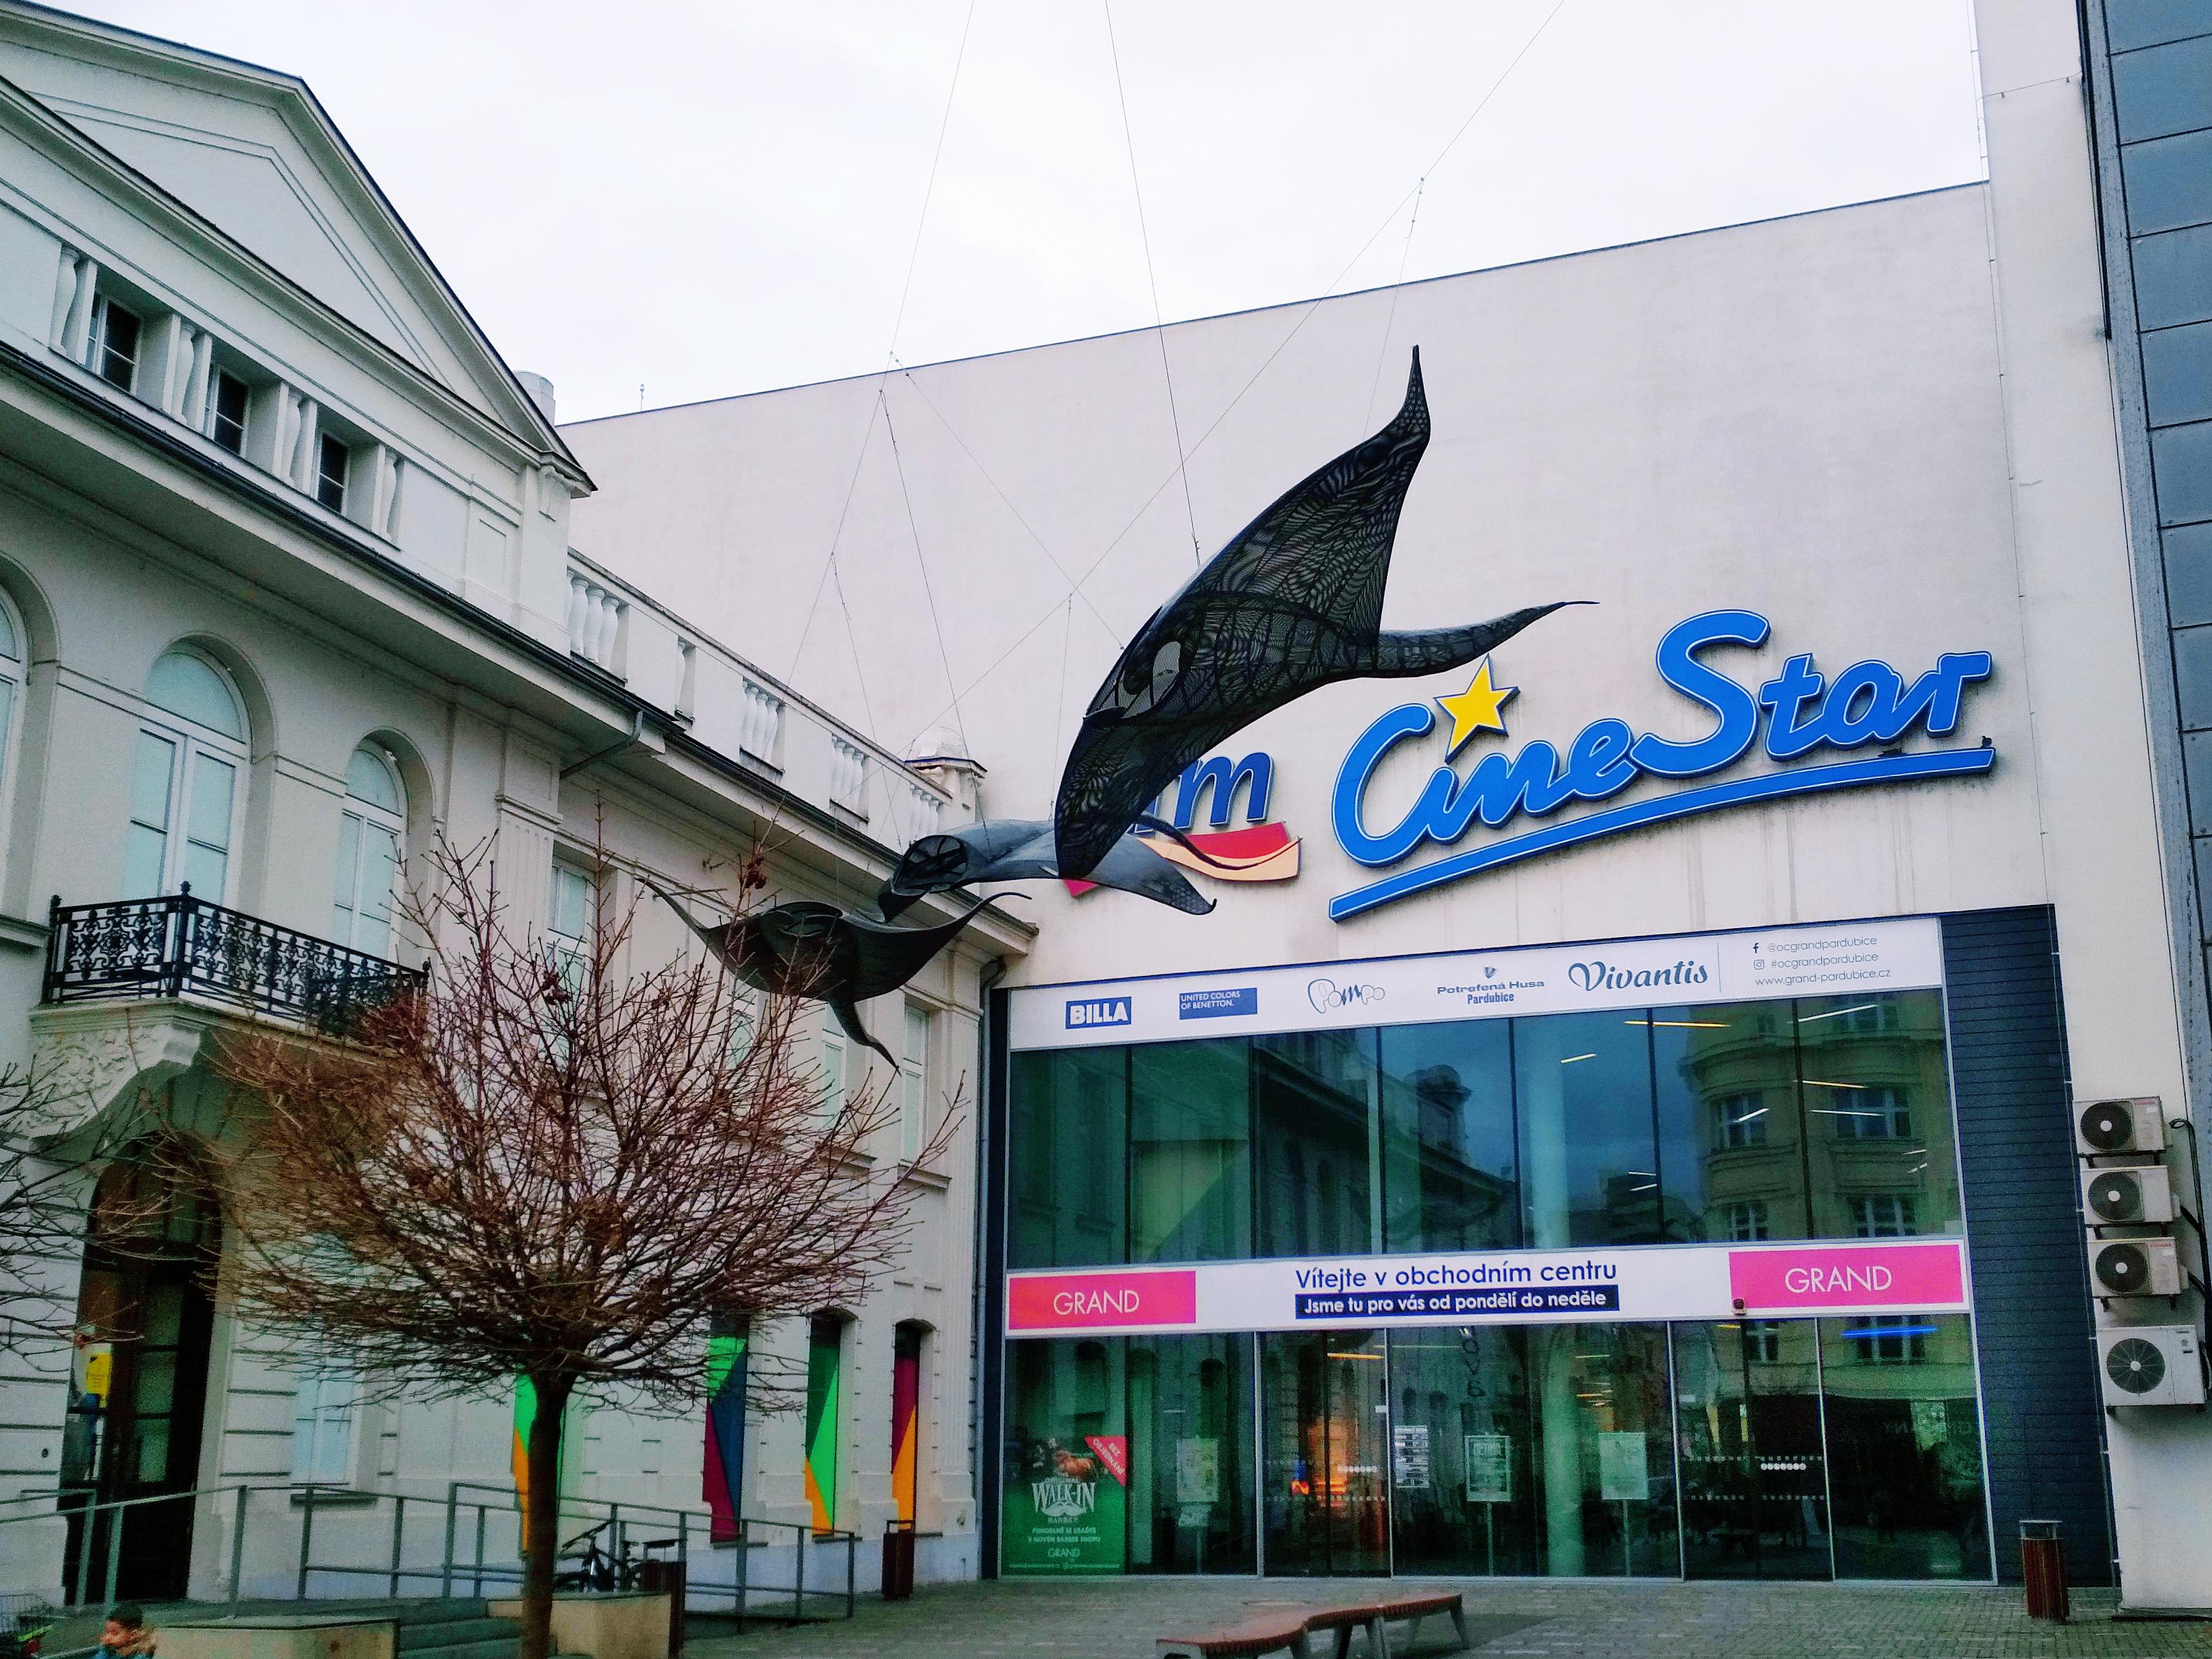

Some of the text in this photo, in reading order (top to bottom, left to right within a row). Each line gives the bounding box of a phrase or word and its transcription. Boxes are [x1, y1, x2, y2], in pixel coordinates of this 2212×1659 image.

[1331, 608, 1991, 868] CineStar
[1128, 752, 1275, 834] m
[1768, 937, 1877, 953] @ocgrandpardubice
[1771, 953, 1878, 969] #ocgrandpardubice
[1568, 960, 1708, 991] Vivantis
[1755, 969, 1891, 986] www.grand-pardubice.cz
[1181, 991, 1241, 1002] UNITED COLORS
[1437, 980, 1544, 995] Potrefená Husa
[1468, 993, 1514, 1005] Pardubice
[1070, 1002, 1128, 1025] BILLA
[1181, 1002, 1192, 1011] OF
[1295, 1260, 1617, 1292] Vítejte v obchodním centru
[1784, 1266, 1893, 1293] GRAND
[1053, 1290, 1141, 1315] GRAND
[1304, 1289, 1606, 1314] Jsme tu pro vás od pondělí do neděle
[1031, 1482, 1095, 1513] WALK-IN
[1047, 1548, 1080, 1558] GRAND
